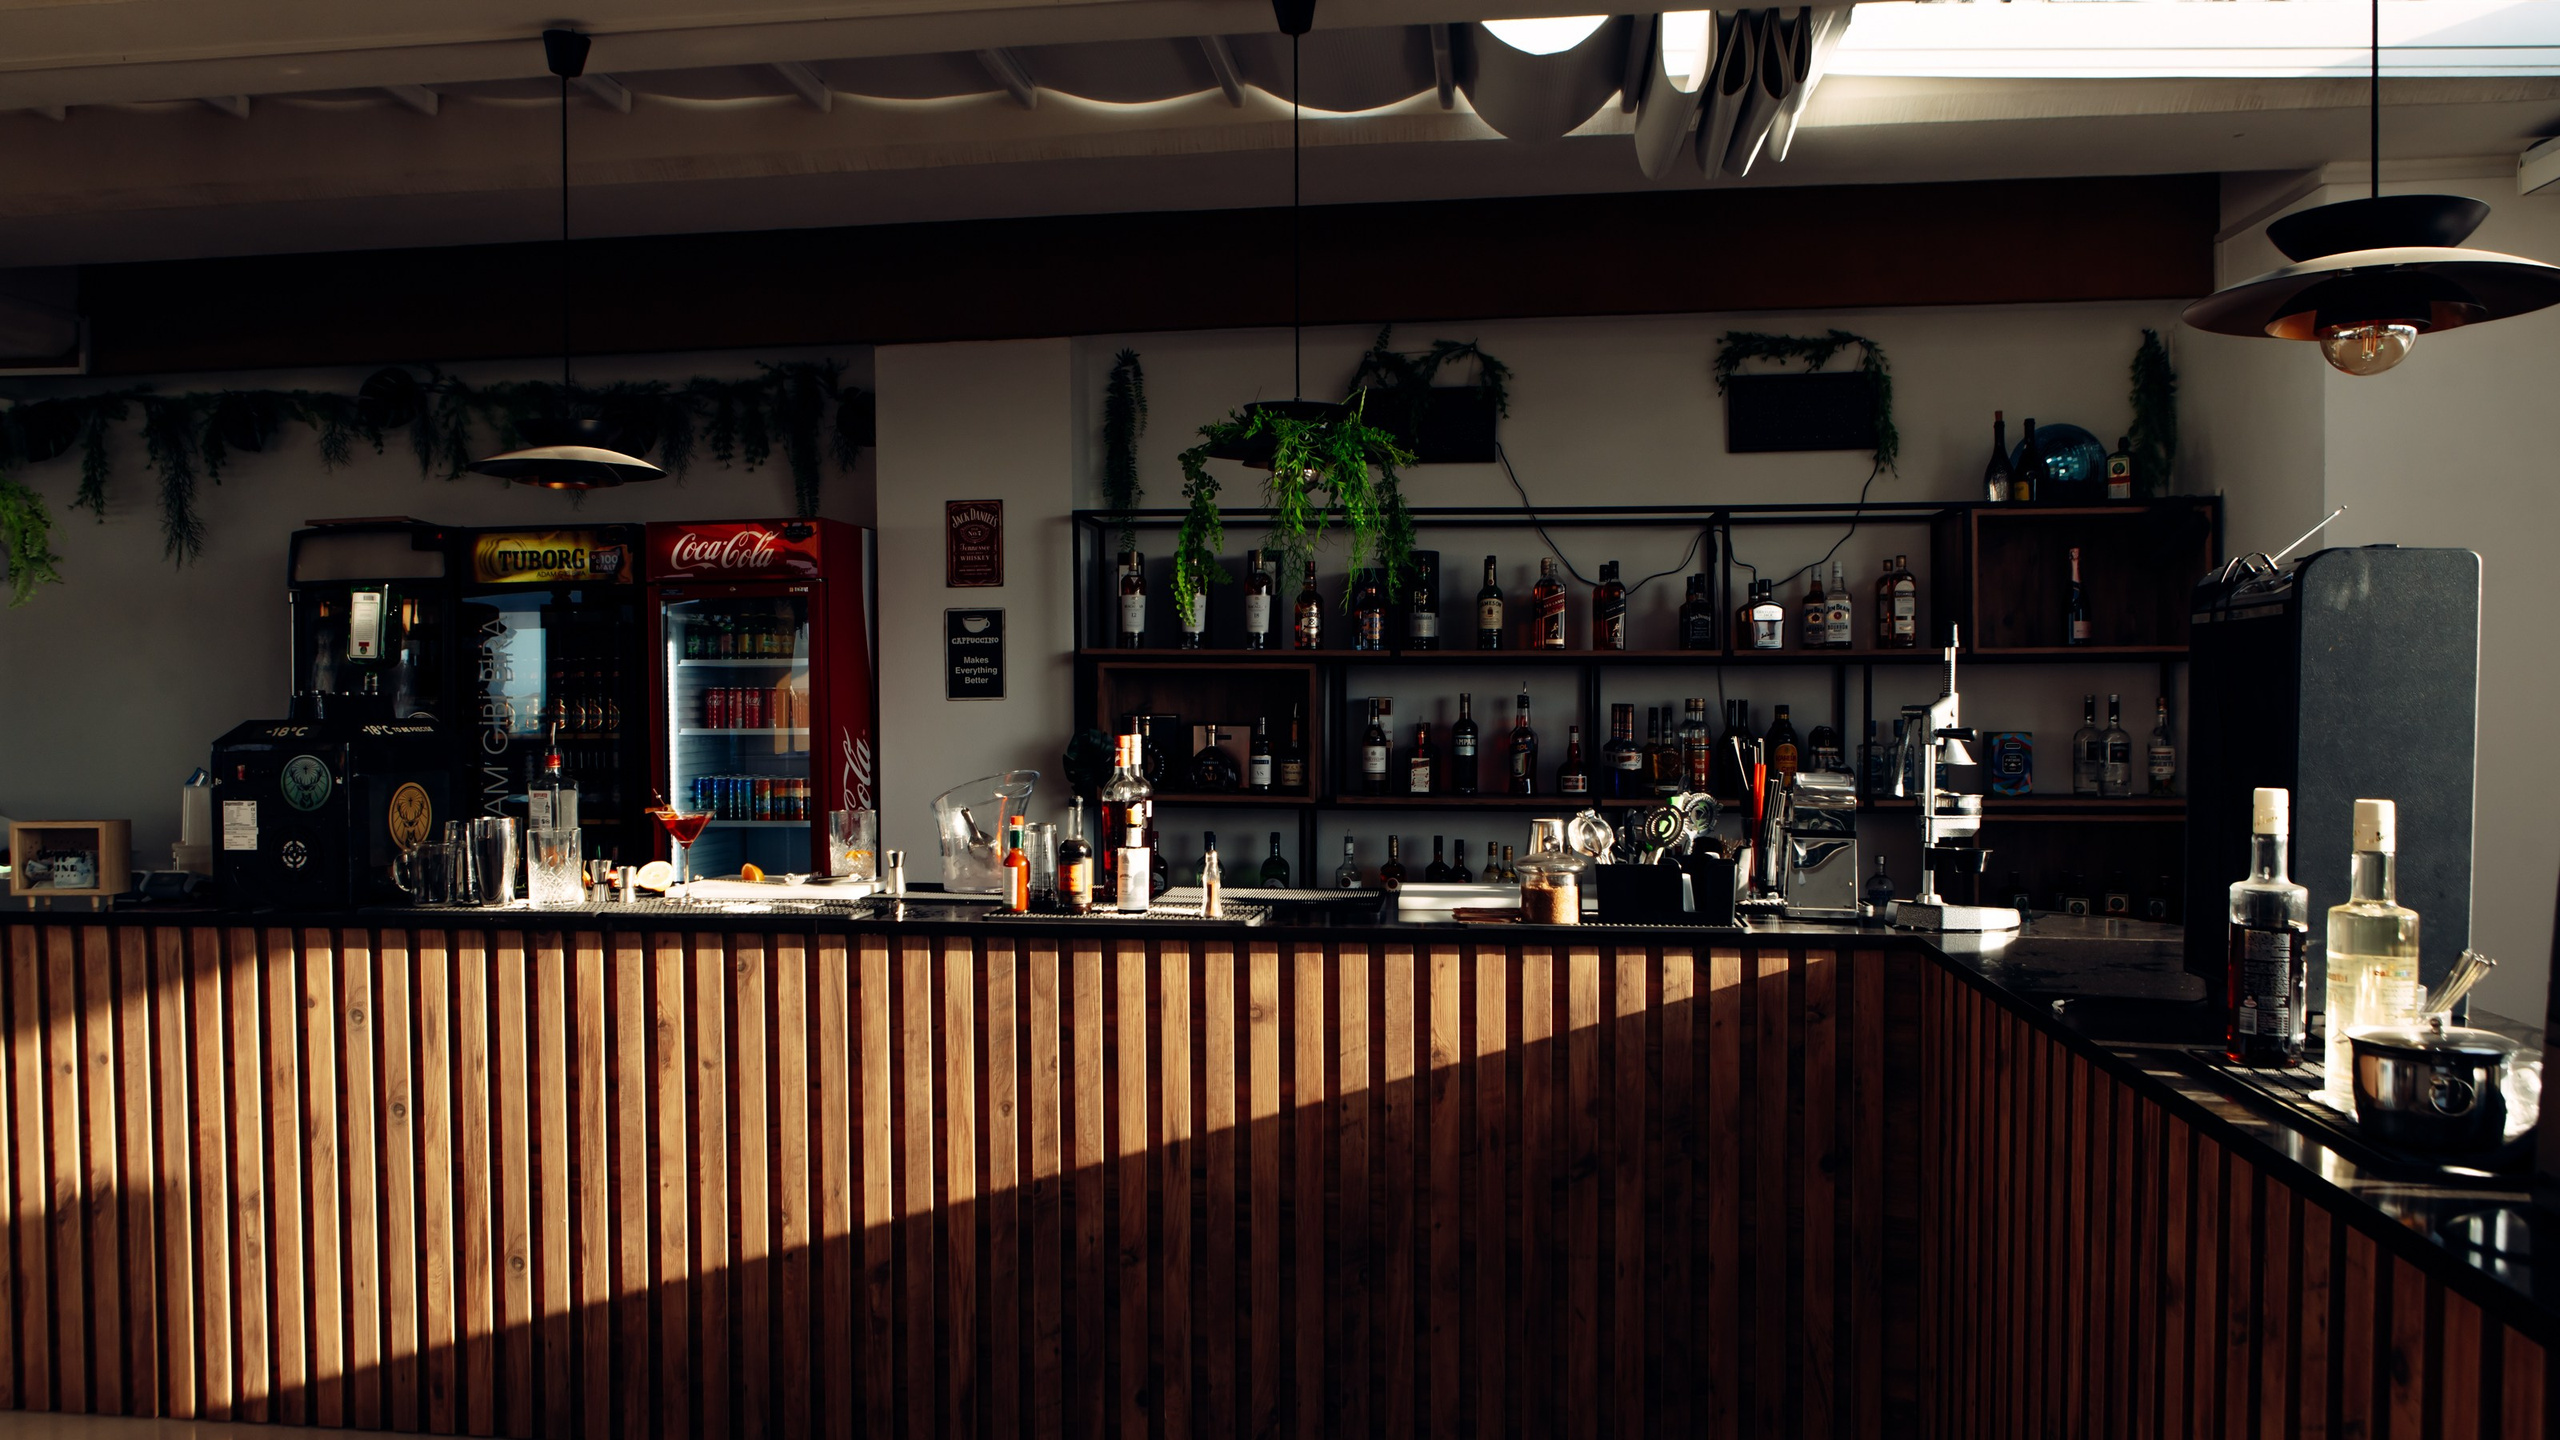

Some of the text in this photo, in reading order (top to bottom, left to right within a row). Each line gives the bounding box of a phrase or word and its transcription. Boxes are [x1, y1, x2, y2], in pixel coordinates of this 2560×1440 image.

[951, 511, 970, 528] JACK
[670, 530, 780, 571] Coca-Cola
[498, 549, 585, 571] TUBORG
[596, 563, 616, 571] MALT
[951, 636, 1000, 645] CAPPUCCINO
[963, 656, 989, 664] Makes
[955, 666, 998, 675] Everything
[964, 676, 989, 685] Better
